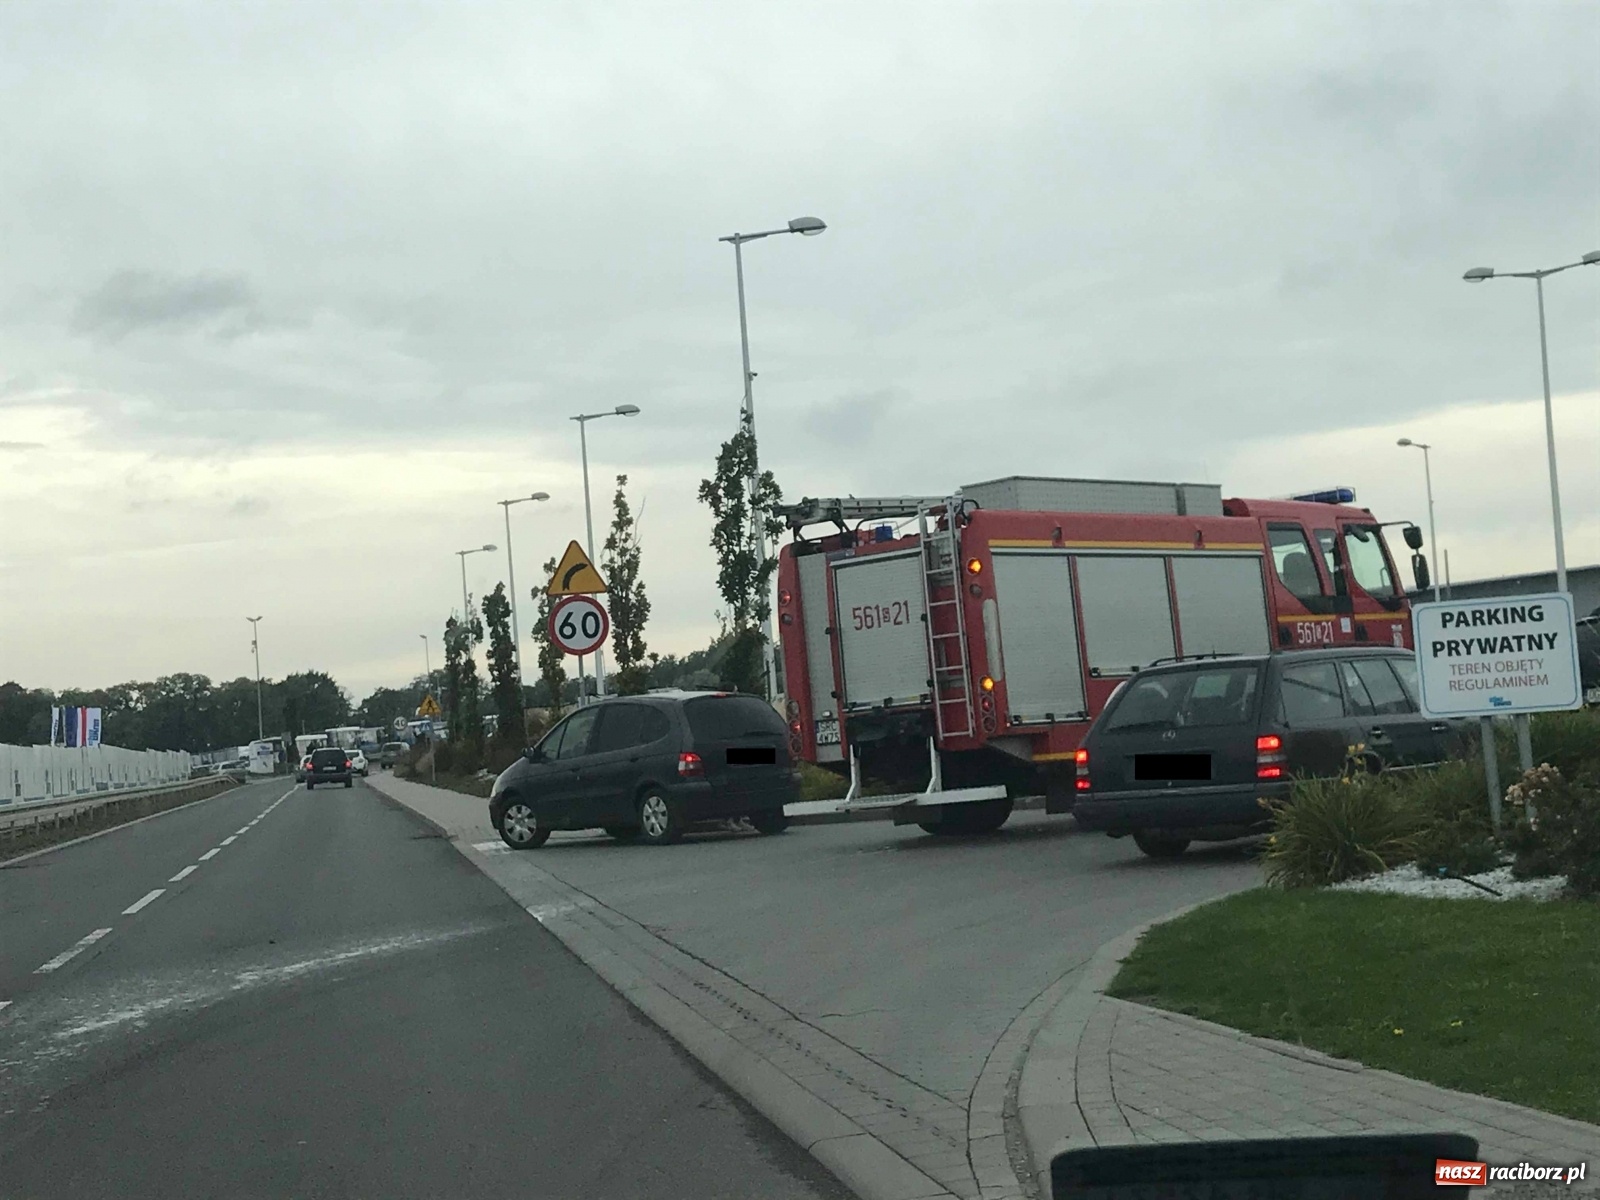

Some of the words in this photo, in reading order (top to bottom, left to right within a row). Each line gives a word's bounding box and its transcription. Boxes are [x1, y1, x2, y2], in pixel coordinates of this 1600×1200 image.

[559, 611, 600, 639] 60
[1441, 605, 1544, 628] PARKING
[1432, 632, 1558, 658] PRYWATNY
[1450, 661, 1491, 676] TEREN
[1495, 658, 1544, 674] OBJĘTY
[1449, 674, 1549, 691] REGULAMINEM
